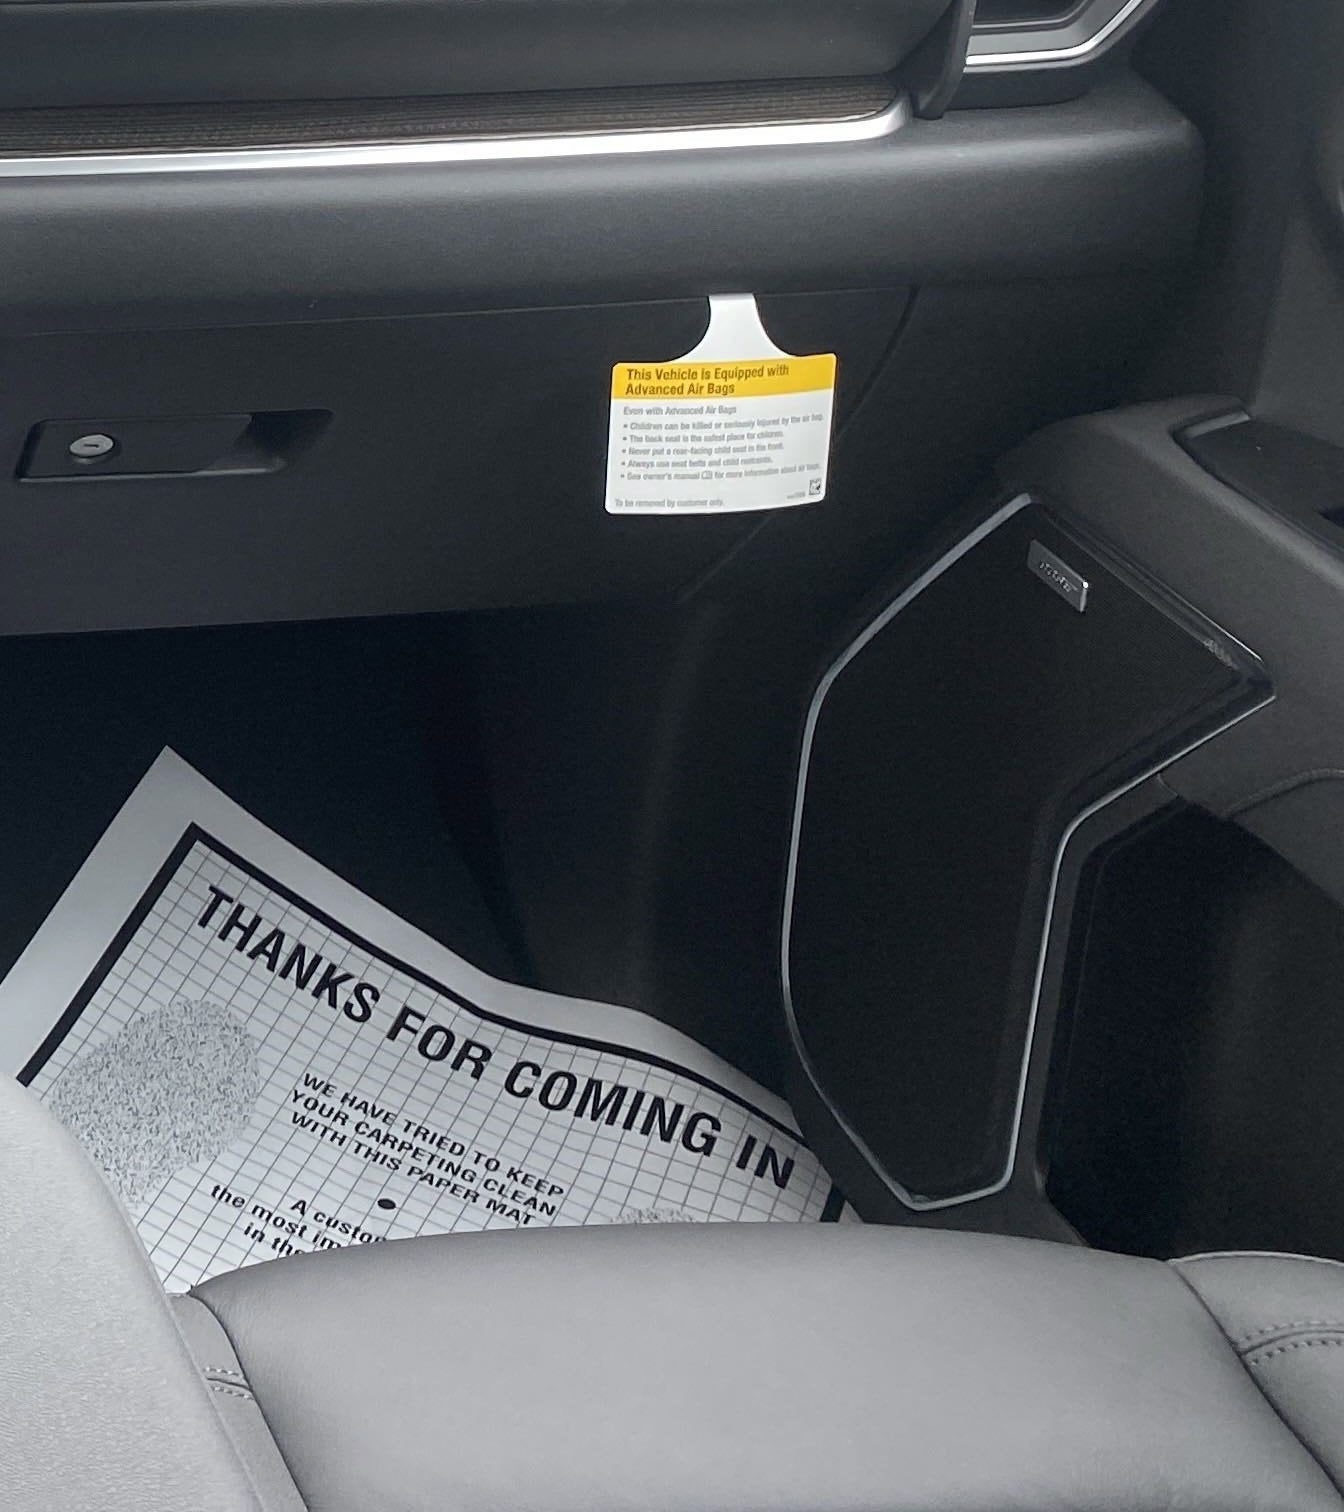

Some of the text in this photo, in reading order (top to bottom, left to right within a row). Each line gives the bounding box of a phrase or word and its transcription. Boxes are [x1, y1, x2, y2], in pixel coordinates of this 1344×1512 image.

[627, 364, 789, 381] This Vehicle is Equipped with
[625, 383, 735, 396] Advanced Air Bags
[623, 405, 736, 415] Even with Advanced Air Bags
[630, 422, 662, 430] Children
[680, 422, 690, 430] be
[692, 421, 712, 429] killed
[628, 447, 650, 455] Never
[627, 459, 654, 468] Always
[643, 472, 671, 480] owner's
[673, 471, 699, 480] manual
[197, 885, 796, 1191] THANKS FOR COMING IN
[303, 1072, 565, 1197] WE HAVE TRIED TO KEEP
[291, 1089, 556, 1217] YOUR CARPETING CLEAN
[291, 1111, 537, 1226] WITH THIS PAPER MAT
[211, 1184, 246, 1209] the
[251, 1203, 308, 1239] most
[290, 1199, 308, 1216] A
[243, 1222, 265, 1244] in
